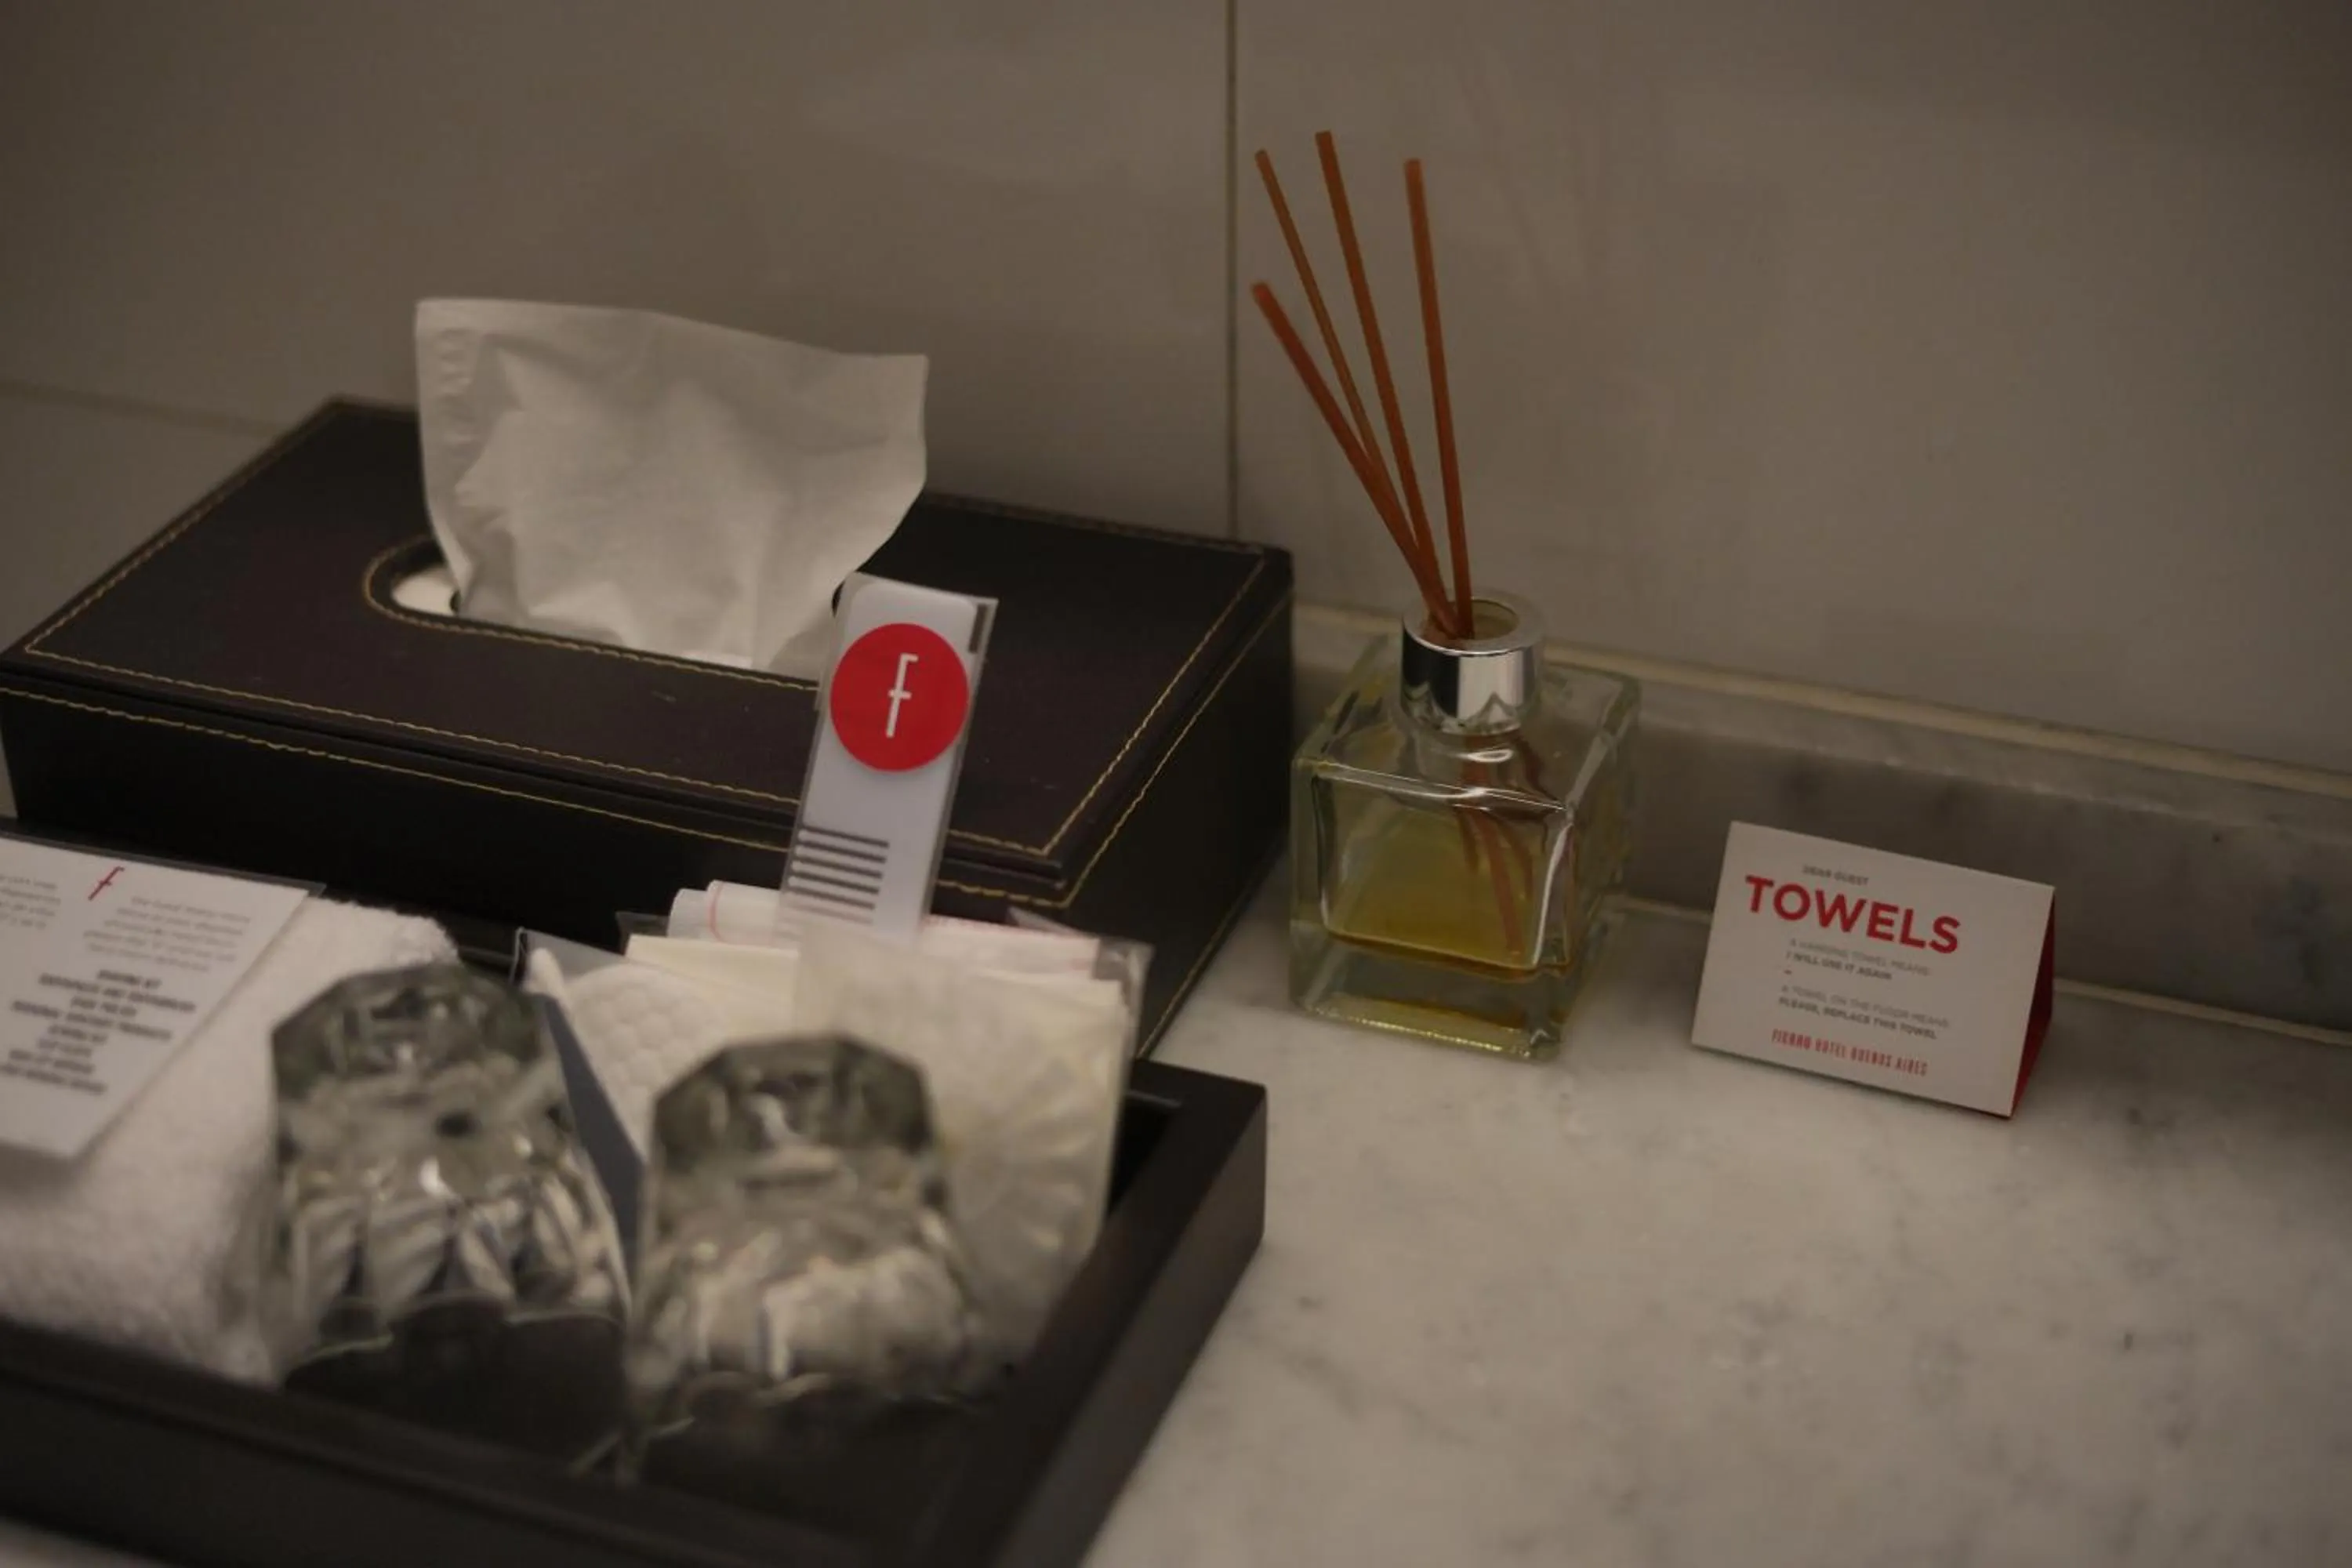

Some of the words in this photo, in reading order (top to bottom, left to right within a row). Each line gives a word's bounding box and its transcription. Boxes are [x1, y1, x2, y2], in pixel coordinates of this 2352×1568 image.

[1834, 871, 1869, 886] GUEST
[1745, 875, 1960, 954] TOWELS
[1793, 952, 1819, 965] WILL
[1821, 957, 1842, 971] USE
[1845, 963, 1855, 973] IT
[1852, 950, 1886, 967] TOWEL
[1791, 985, 1827, 1003] TOWEL
[1830, 993, 1847, 1006] ON
[1850, 997, 1870, 1011] THE
[1873, 1003, 1909, 1019] FLOOR
[1823, 1006, 1871, 1025] REPLACE
[1874, 1017, 1897, 1031] THIS
[1772, 1029, 1812, 1051] FIERRO
[1815, 1038, 1847, 1058] HOTEL
[1850, 1046, 1893, 1068] BUENOS
[1896, 1056, 1929, 1076] AIRES
